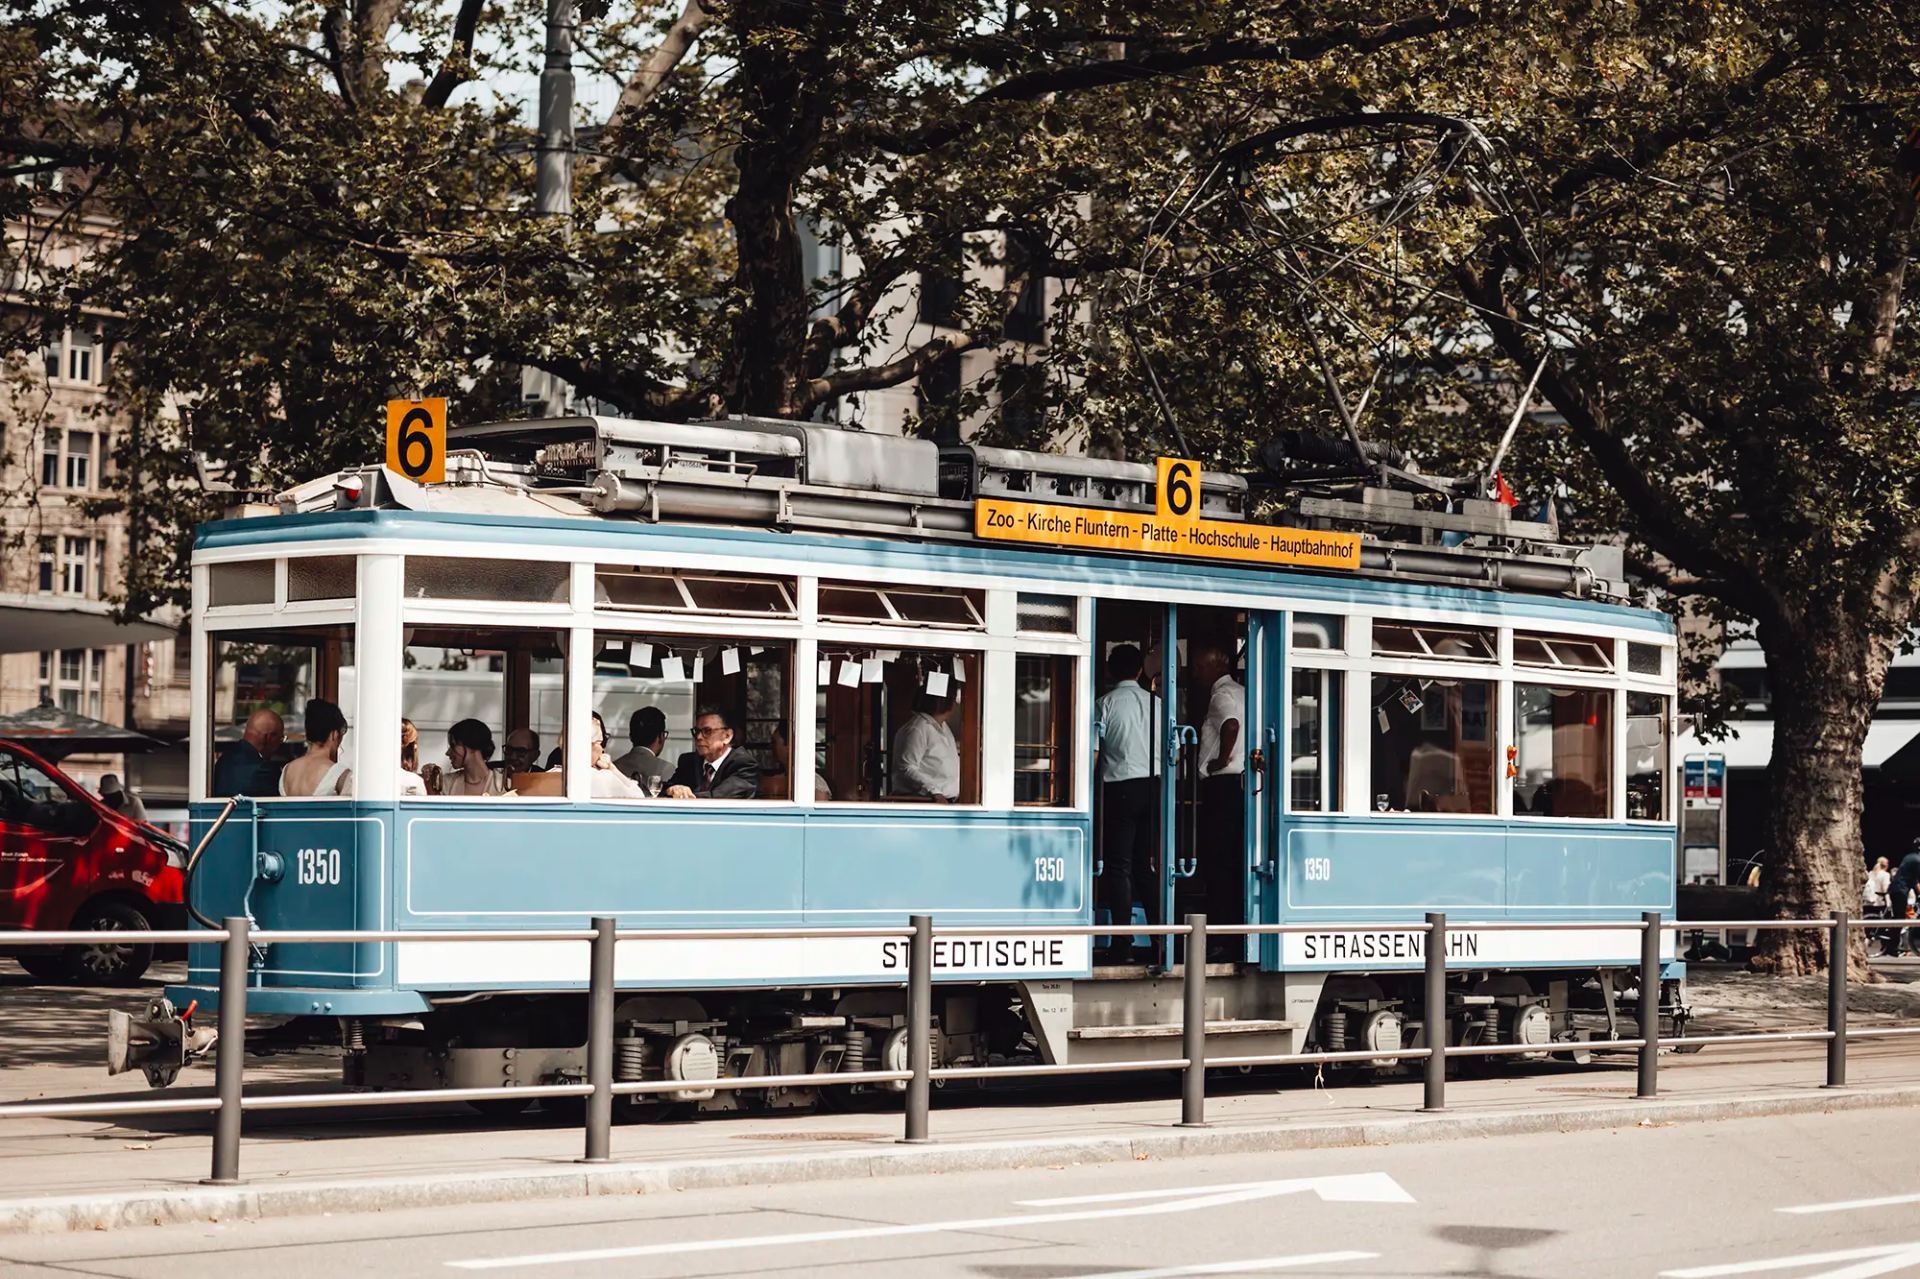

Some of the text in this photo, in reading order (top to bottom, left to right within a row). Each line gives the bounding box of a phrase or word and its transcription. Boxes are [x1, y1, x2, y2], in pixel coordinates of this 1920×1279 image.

[398, 407, 433, 478] 6
[1166, 462, 1192, 516] 6
[987, 508, 1015, 528] Zoo
[1027, 512, 1072, 533] Kirche
[1075, 516, 1130, 539] Fluntern
[1141, 522, 1178, 542] Platte
[1189, 527, 1260, 550] Hochschule
[1270, 534, 1354, 559] Hauptbahnhof
[297, 848, 341, 884] 1350
[1034, 857, 1064, 882] 1350
[1304, 857, 1331, 881] 1350
[882, 940, 1064, 968] STEDTISCHE
[1304, 933, 1478, 959] STRASSENHN
